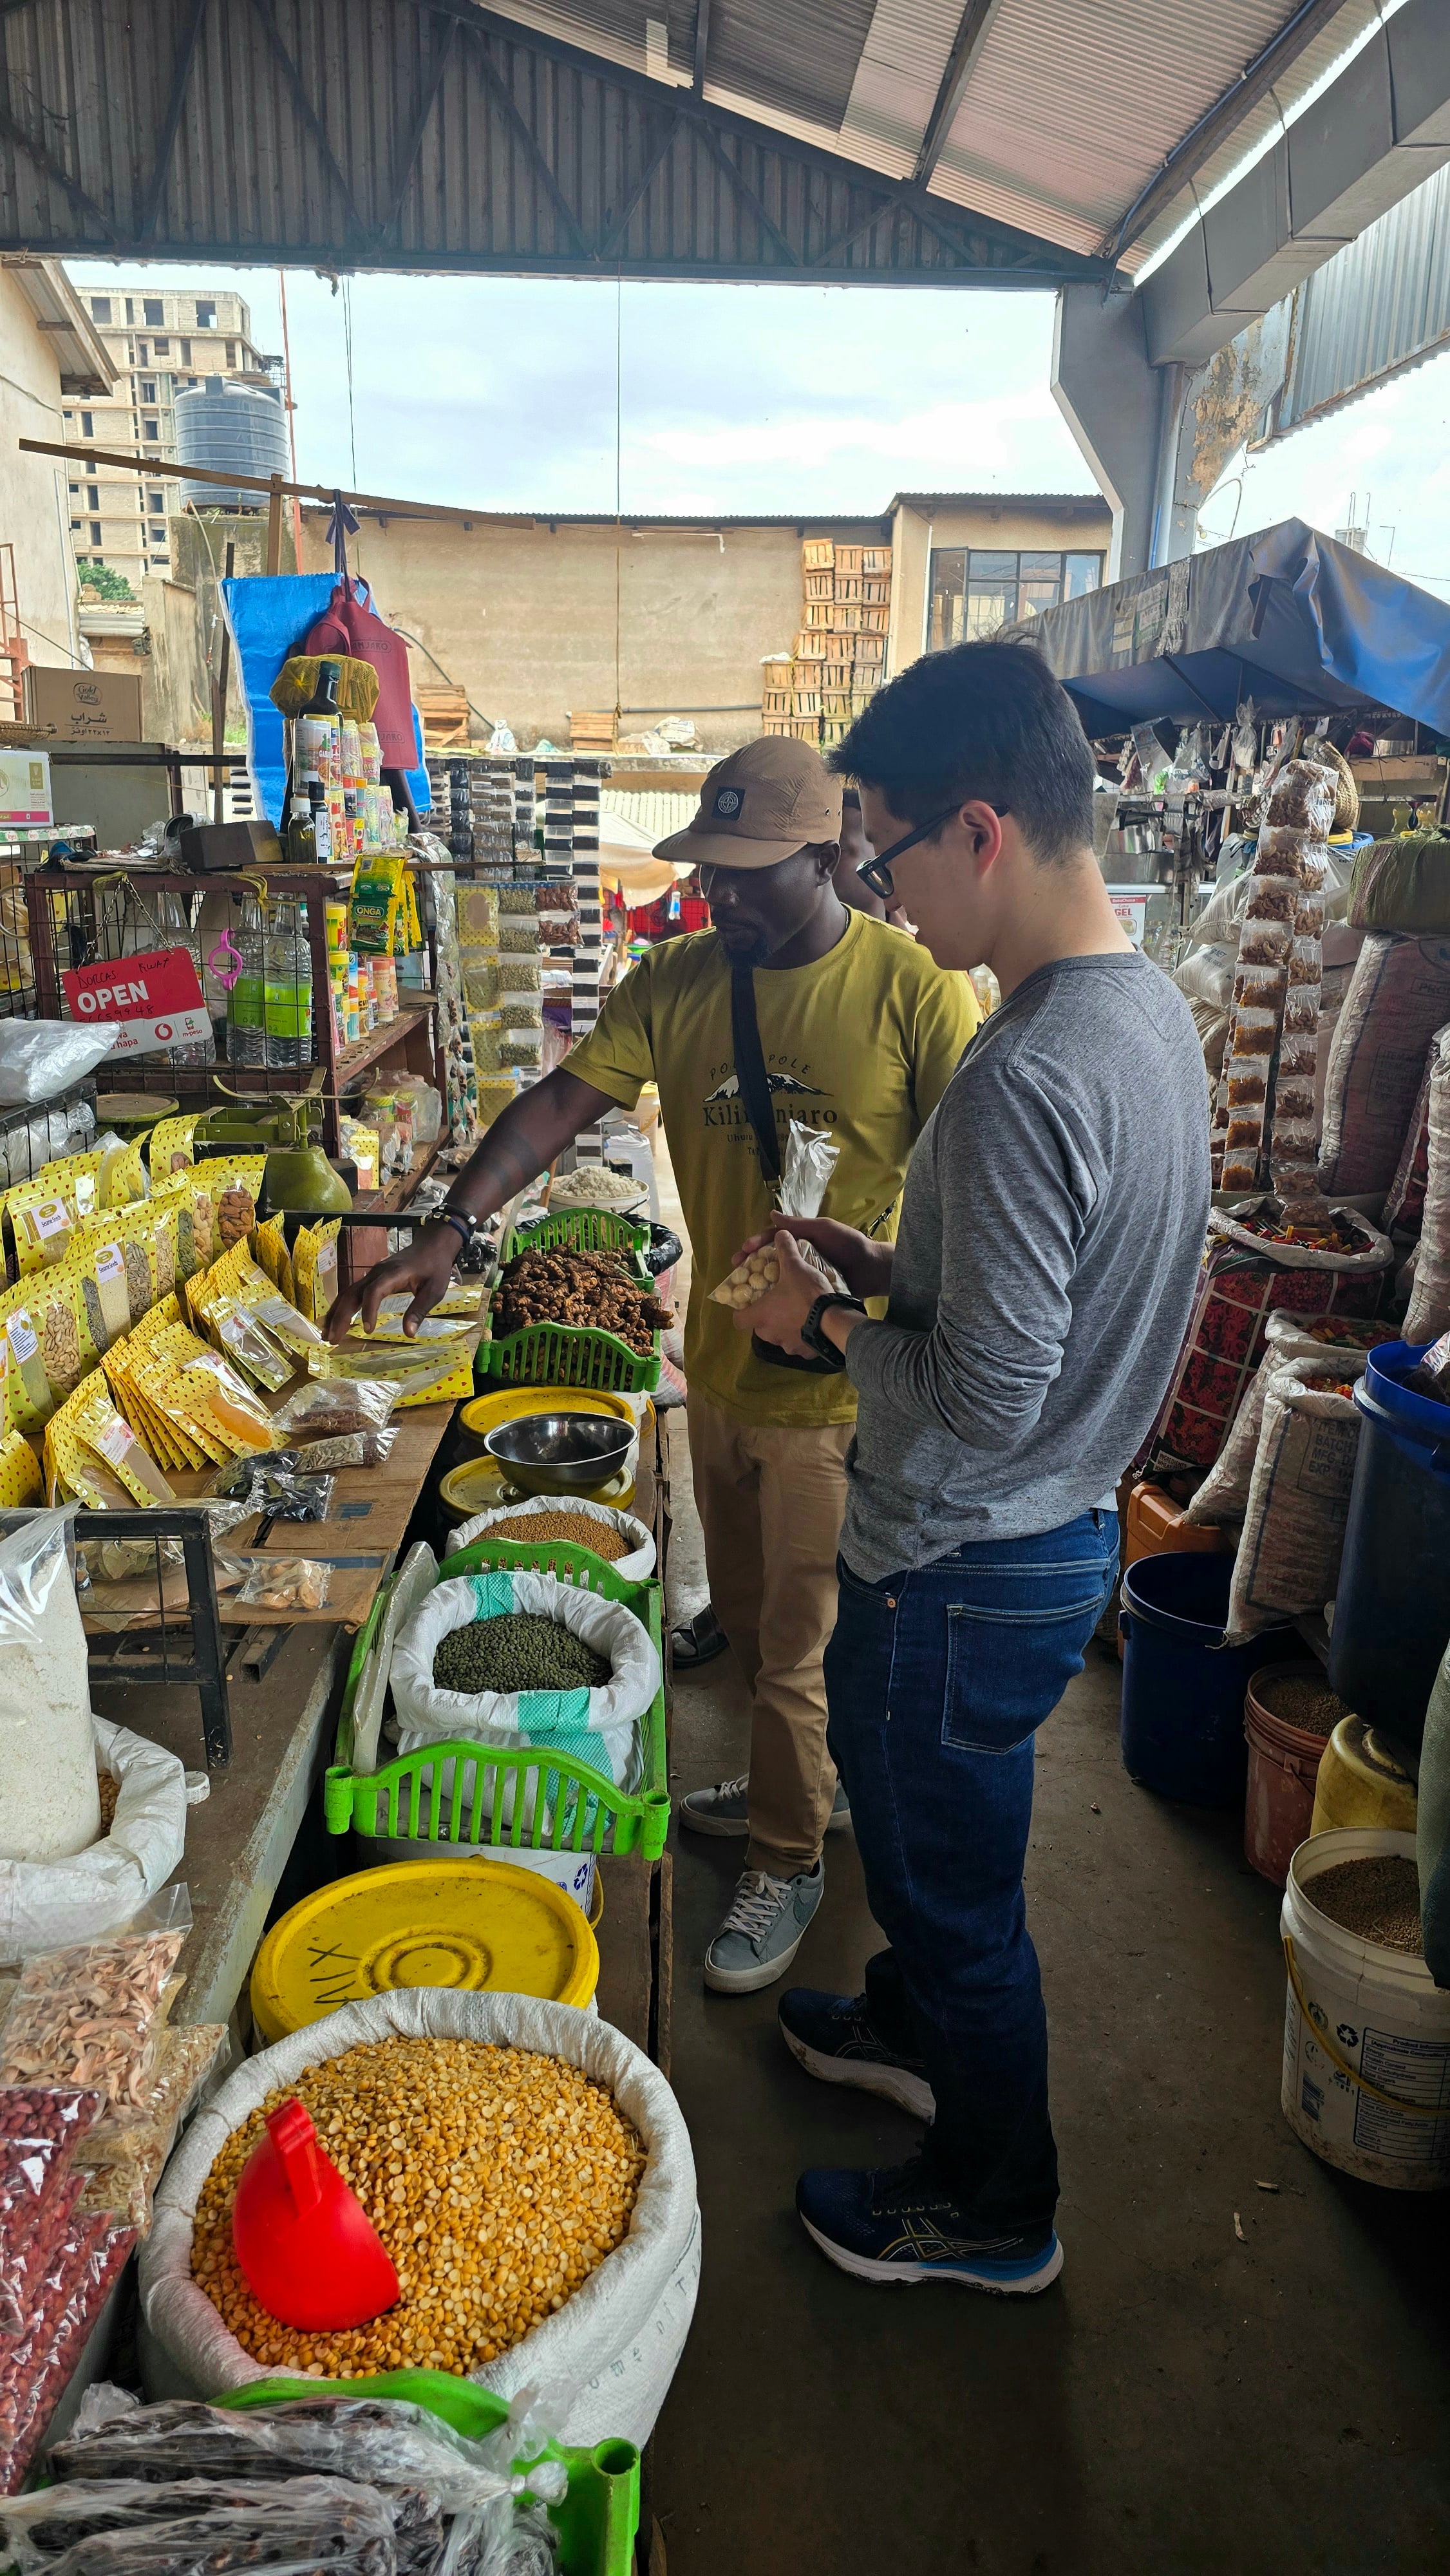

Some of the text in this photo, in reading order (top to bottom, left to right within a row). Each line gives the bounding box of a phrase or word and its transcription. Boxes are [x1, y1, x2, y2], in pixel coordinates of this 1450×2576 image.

[78, 685, 97, 695] Gold
[71, 712, 108, 725] شراب
[357, 907, 382, 916] ONGA
[77, 980, 149, 1013] OPEN
[182, 1029, 203, 1037] m-pesa
[117, 1038, 138, 1048] hapa
[769, 1054, 811, 1074] POLE
[702, 1103, 838, 1126] Kilinjaro
[727, 1133, 753, 1142] Uhuru
[1315, 1434, 1353, 1454] BATCH
[1393, 2038, 1418, 2049] Product
[1366, 2047, 1384, 2057] Energy
[1365, 2054, 1384, 2065] Protein
[1365, 2062, 1377, 2070] Total
